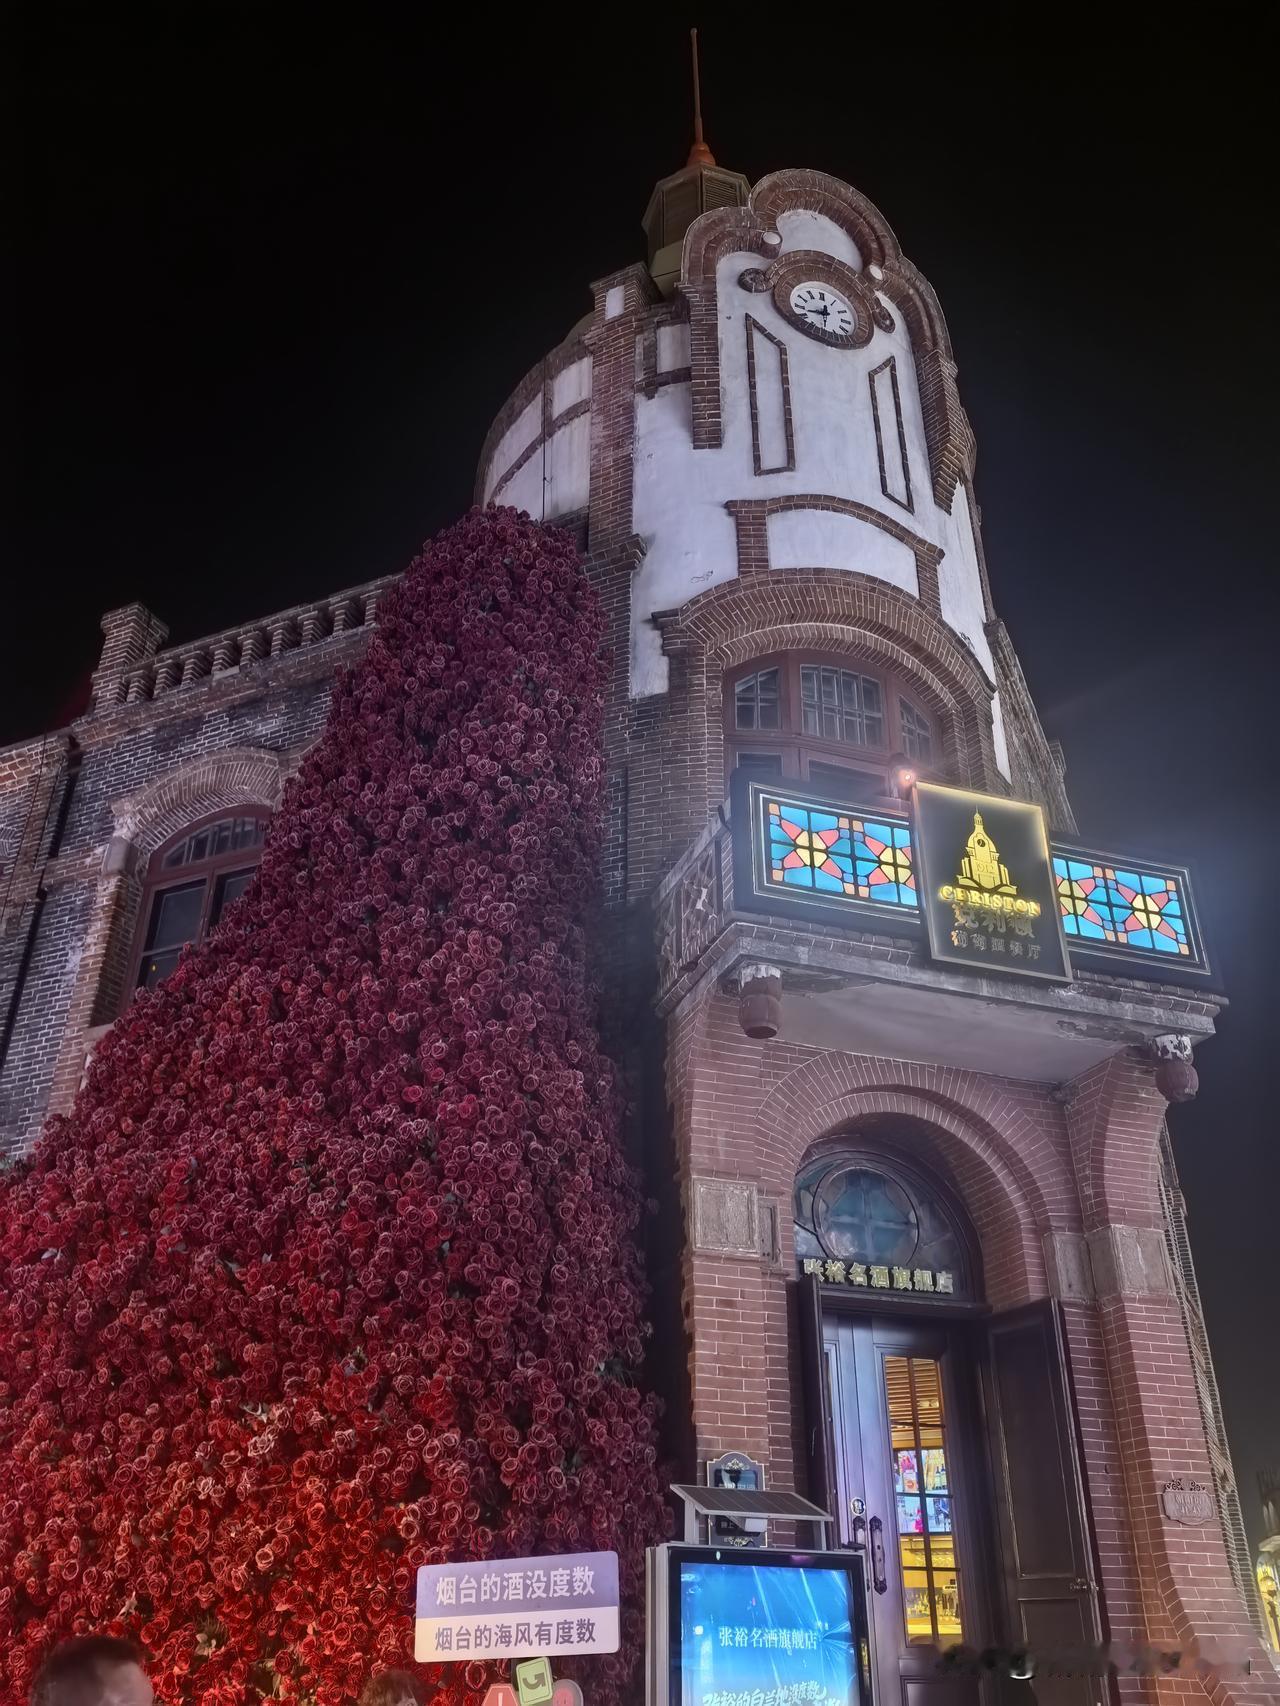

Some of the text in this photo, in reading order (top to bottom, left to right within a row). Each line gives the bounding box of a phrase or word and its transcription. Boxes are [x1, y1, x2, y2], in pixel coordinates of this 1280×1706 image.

[803, 1258, 954, 1294] 张裕名酒旗舰店
[436, 1565, 596, 1606] 烟台的酒没度数
[434, 1617, 597, 1651] 烟台的海风有度数
[718, 1625, 818, 1650] 张裕名酒旗舰店
